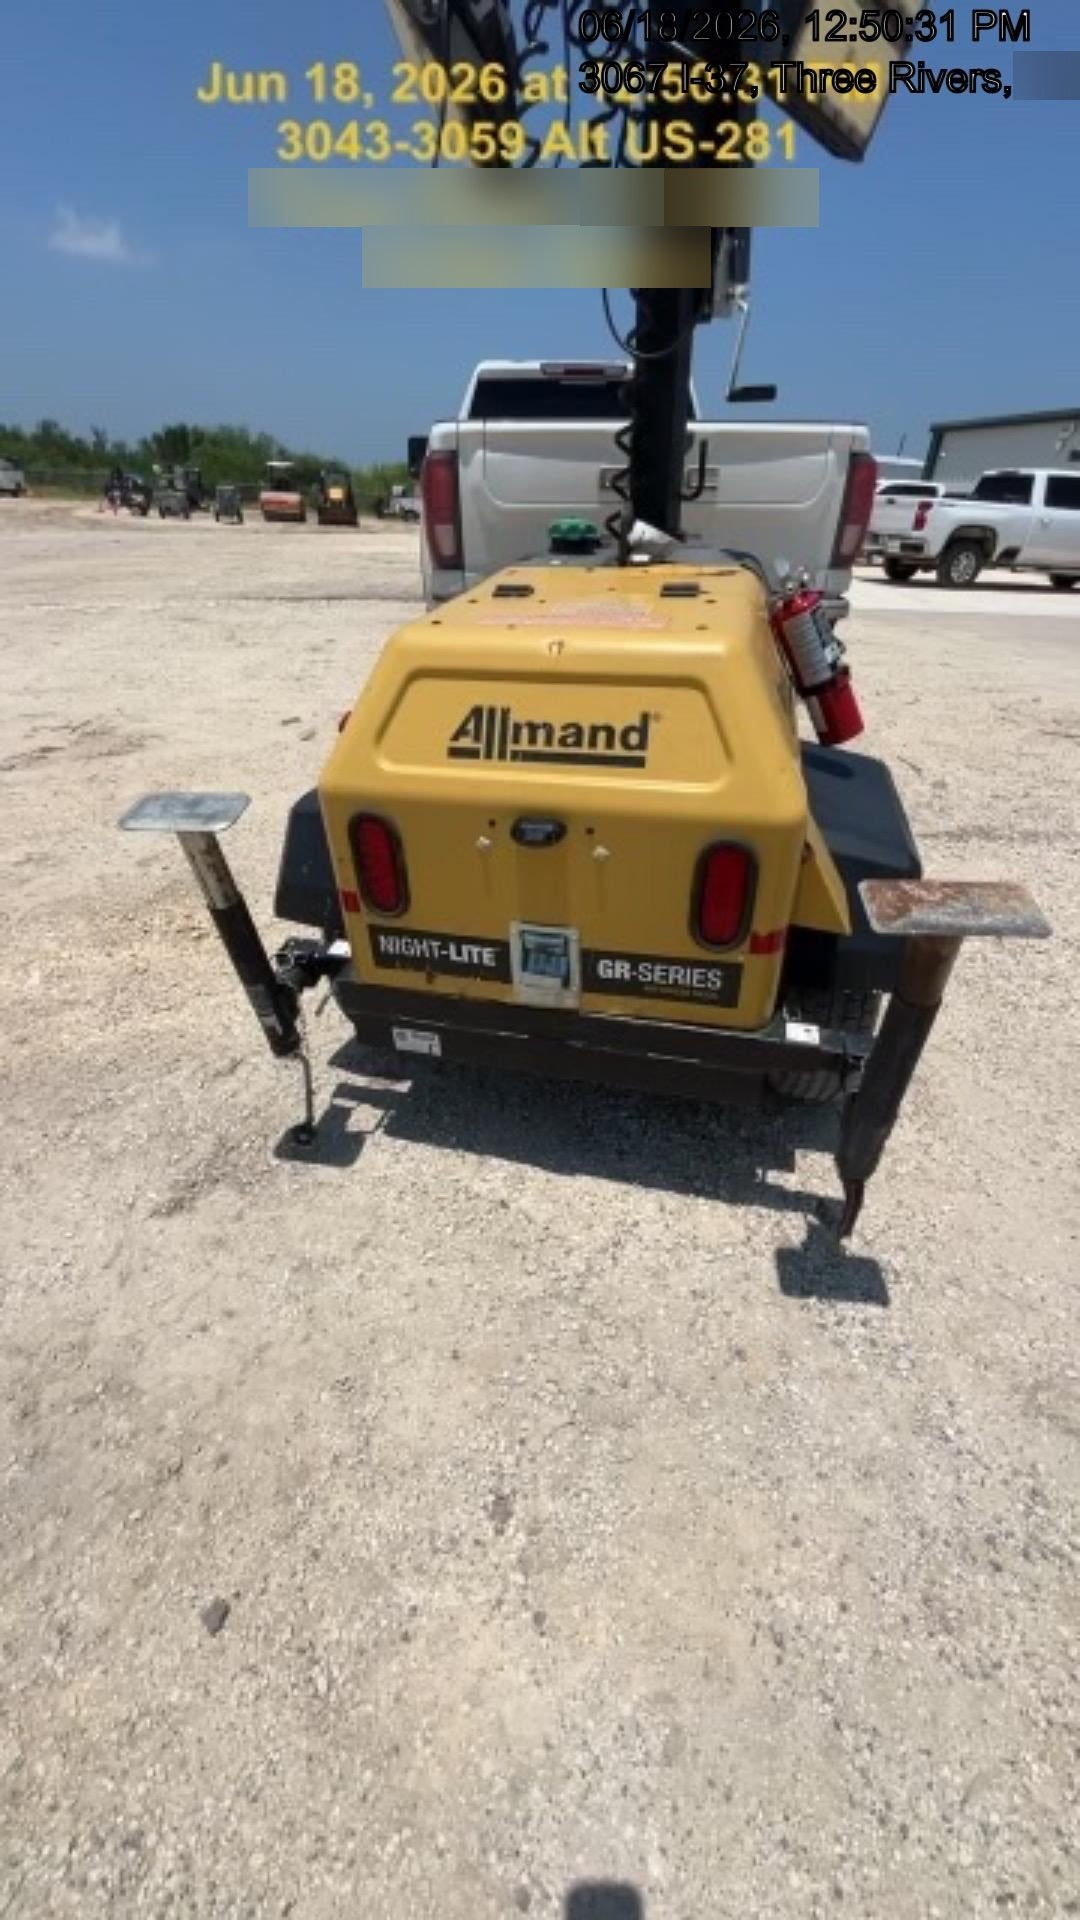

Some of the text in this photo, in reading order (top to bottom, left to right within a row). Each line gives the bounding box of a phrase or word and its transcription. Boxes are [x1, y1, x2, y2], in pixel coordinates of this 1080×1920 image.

[448, 704, 650, 767] Allmand
[378, 935, 498, 967] NIGHT-LITE
[597, 959, 722, 990] GR-SERIES
